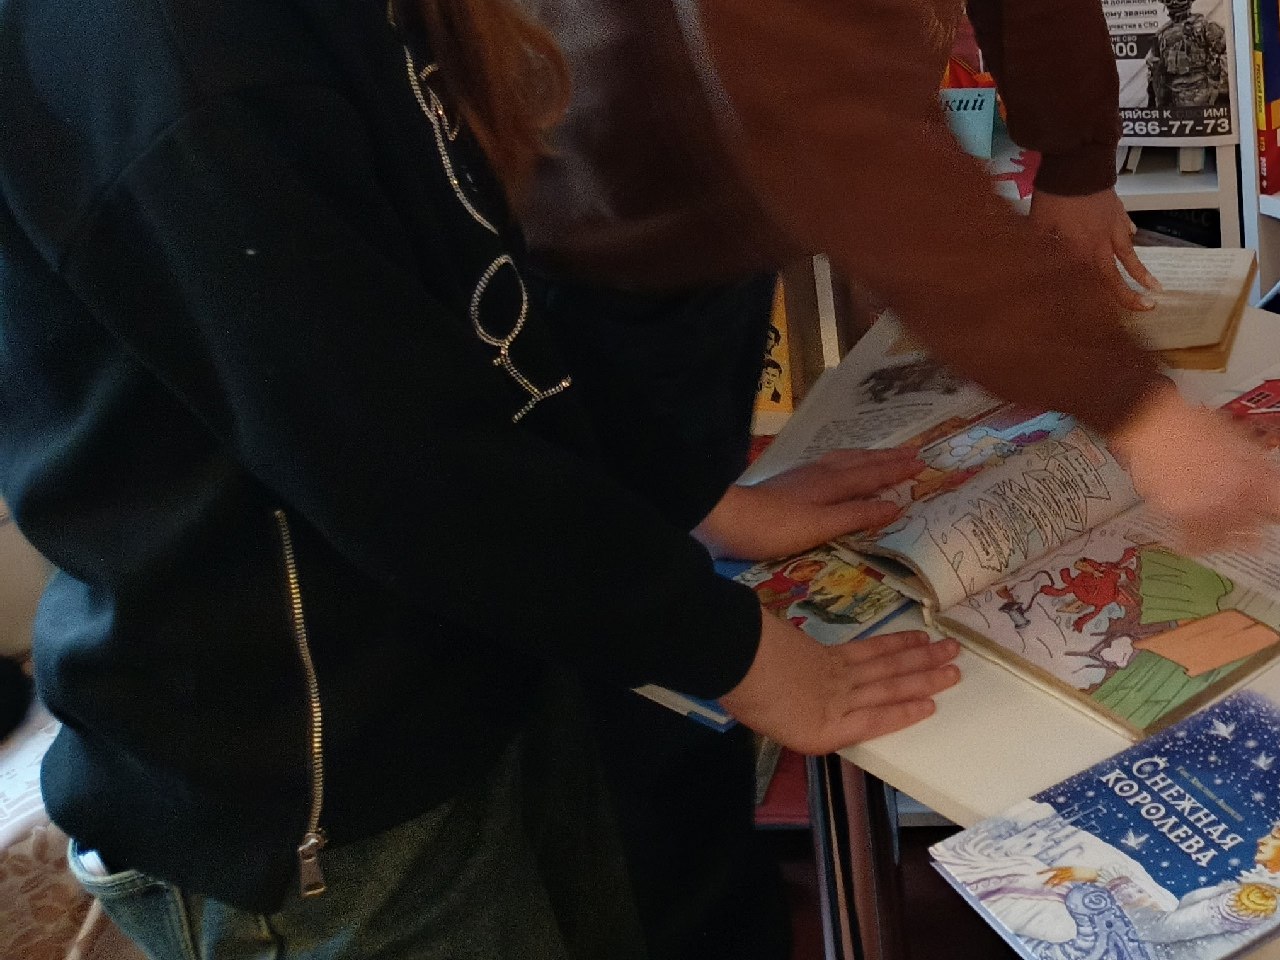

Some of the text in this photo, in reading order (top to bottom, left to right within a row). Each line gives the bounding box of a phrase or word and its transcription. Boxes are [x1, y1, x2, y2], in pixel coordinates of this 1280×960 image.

[943, 90, 986, 112] кий
[1099, 768, 1219, 868] КОРОЛЕВА
[1132, 754, 1245, 851] СНЕЖНАЯ
